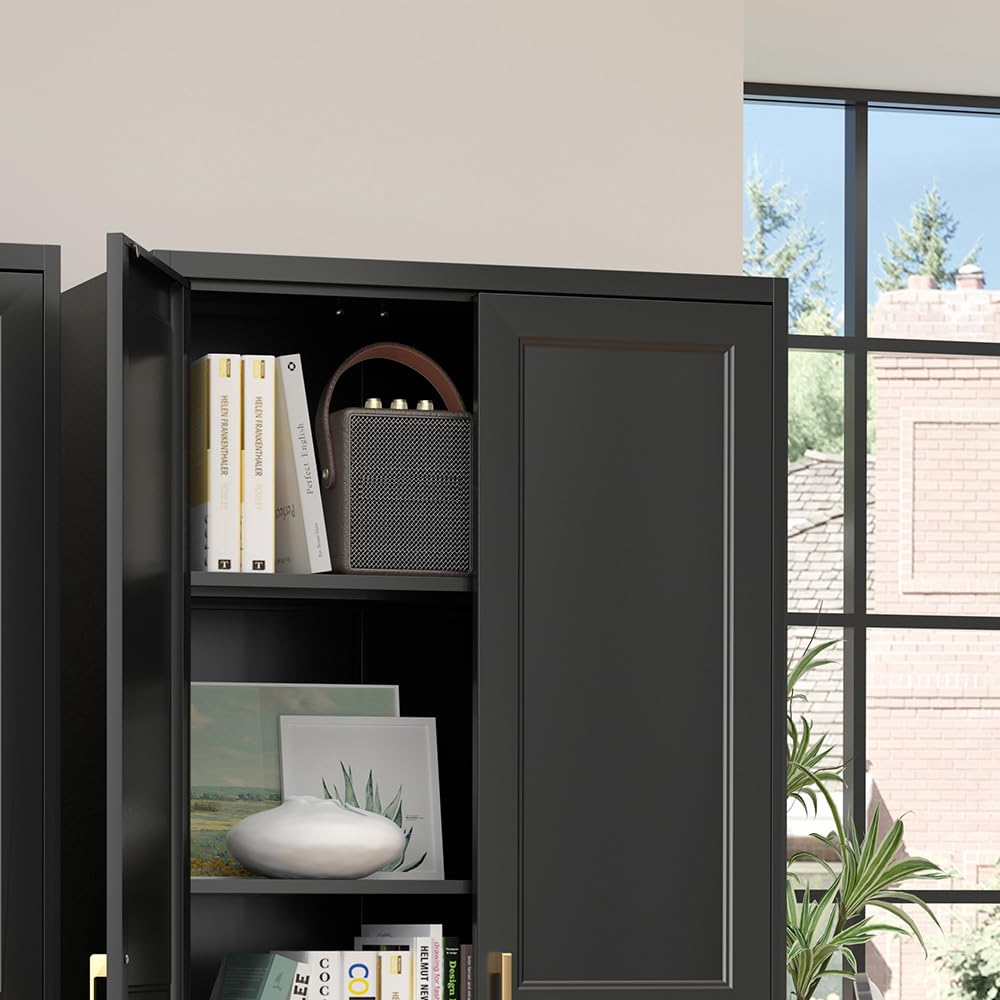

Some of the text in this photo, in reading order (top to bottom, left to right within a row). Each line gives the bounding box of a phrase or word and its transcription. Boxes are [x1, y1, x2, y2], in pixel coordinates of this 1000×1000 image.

[220, 395, 229, 417] HELEN
[255, 396, 263, 418] HELEN
[220, 418, 229, 476] FRANKENTHALER
[255, 419, 263, 477] FRANKENTHALER
[297, 423, 314, 495] Perfect English
[420, 945, 429, 981] HELMUT
[447, 960, 456, 996] Design
